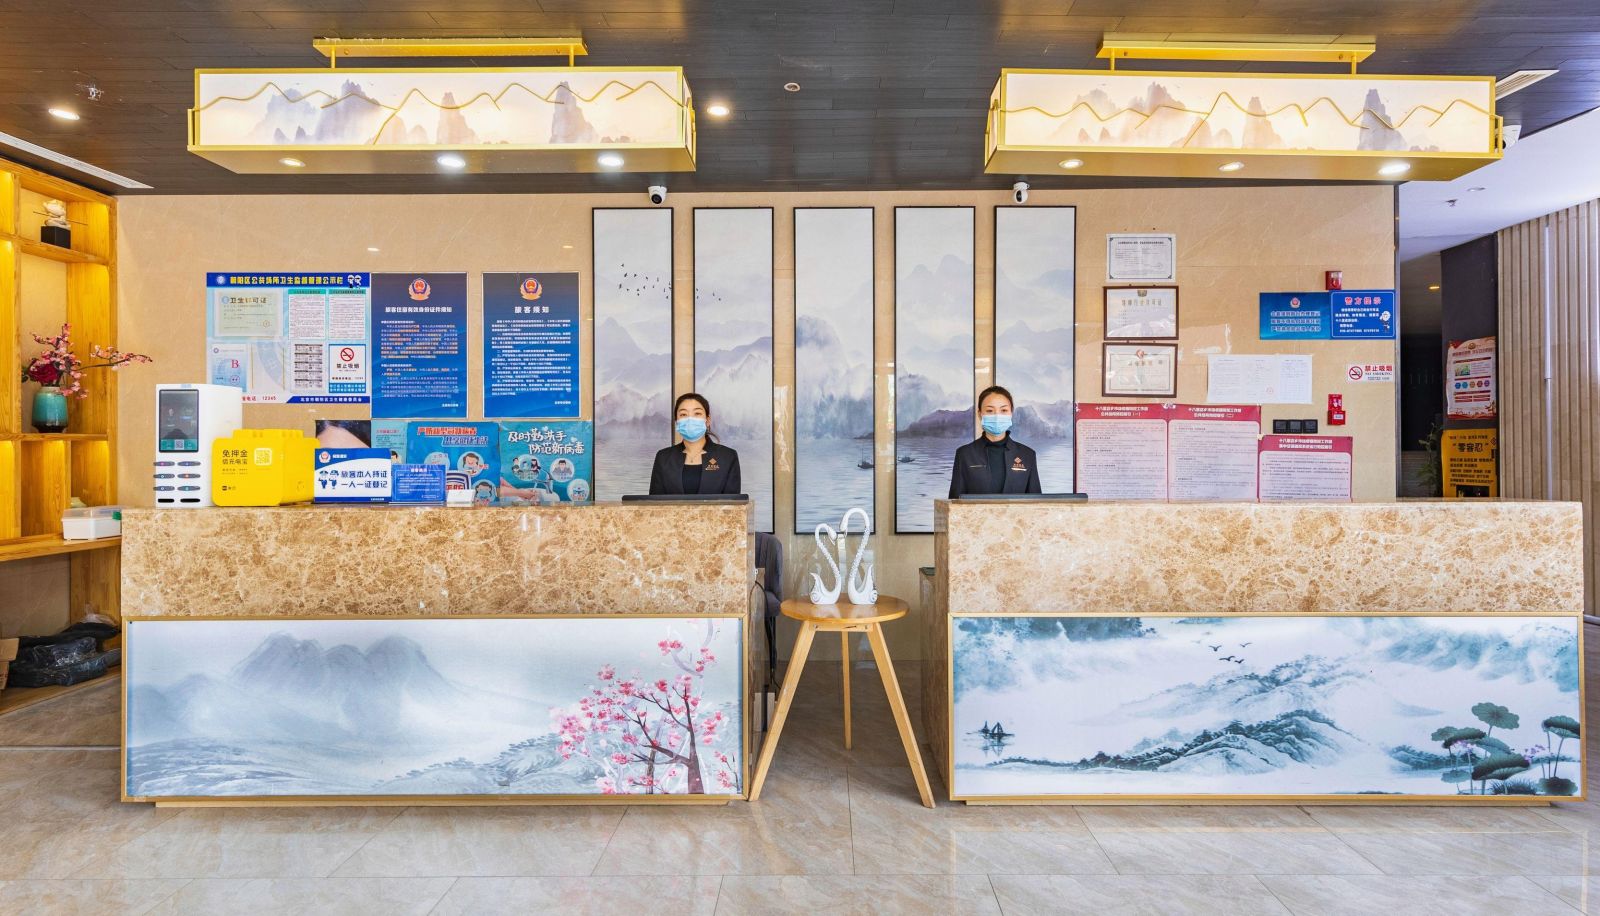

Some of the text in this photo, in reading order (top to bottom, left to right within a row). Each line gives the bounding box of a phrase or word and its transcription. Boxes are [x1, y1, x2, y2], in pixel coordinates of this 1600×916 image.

[514, 306, 550, 314] 旅客须知
[231, 359, 239, 369] B
[508, 427, 567, 442] 及时勤洗手
[529, 441, 585, 455] 防范新病毒
[222, 449, 248, 458] 免押金
[341, 470, 388, 479] 旅客本人持证
[341, 480, 388, 489] 一人一证登记
